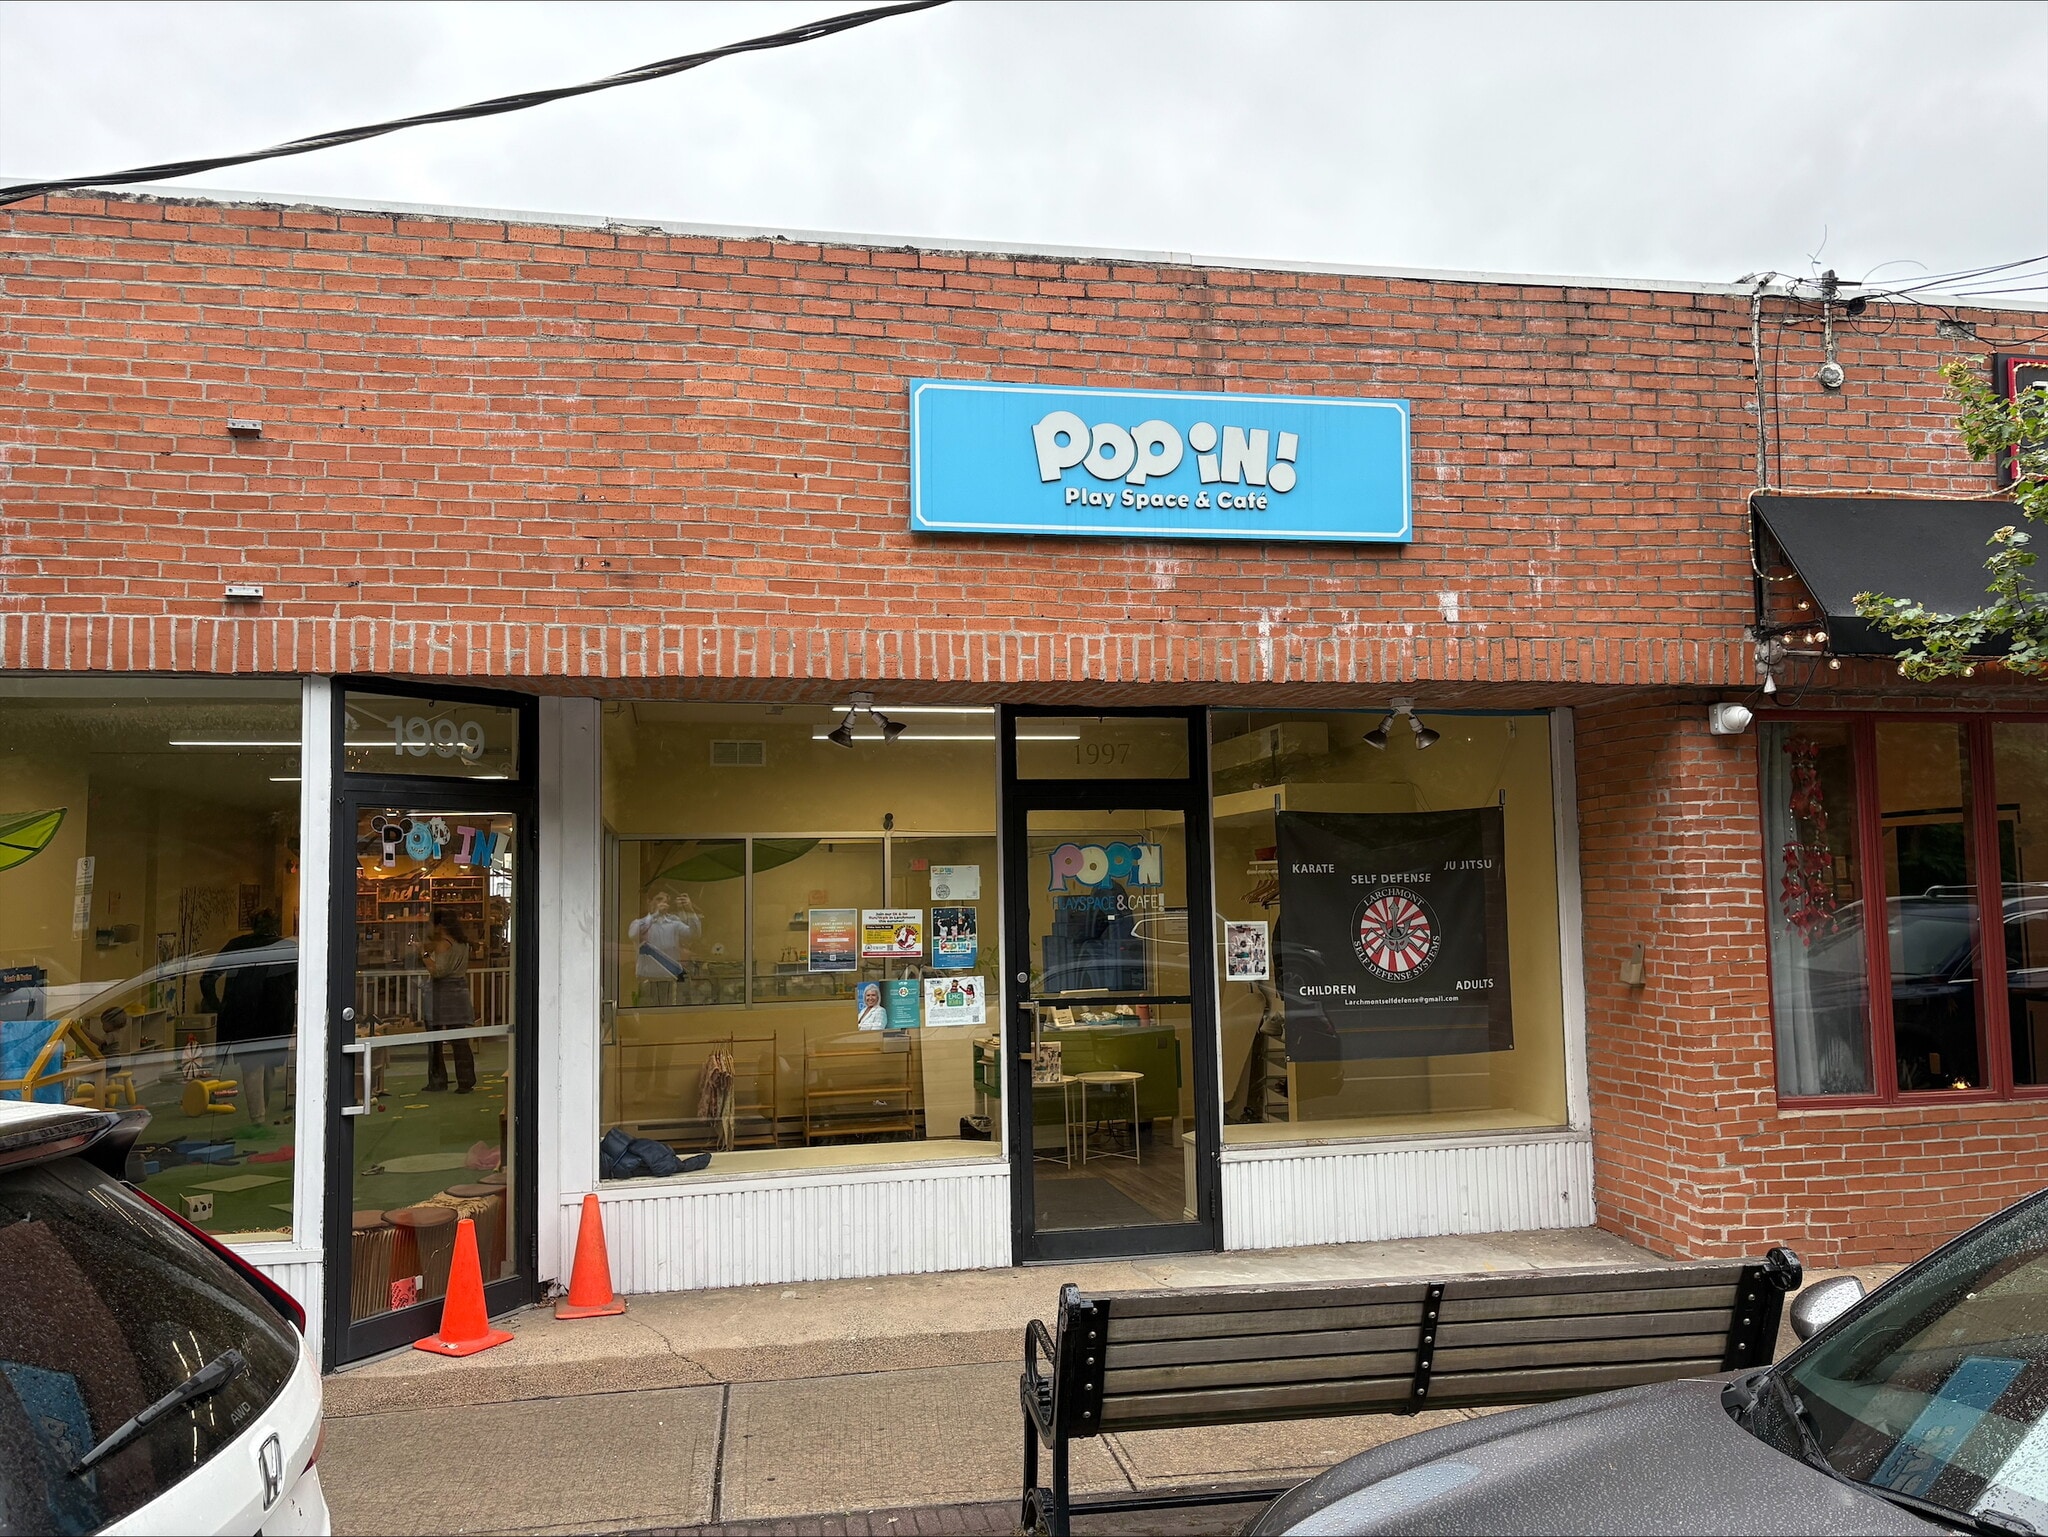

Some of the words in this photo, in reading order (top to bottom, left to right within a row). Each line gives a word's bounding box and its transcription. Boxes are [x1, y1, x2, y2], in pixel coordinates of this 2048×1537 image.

[1065, 487, 1114, 510] Play
[1121, 488, 1190, 512] Space
[1195, 491, 1211, 509] &
[1217, 491, 1268, 511] Café
[387, 715, 485, 760] 1999
[1073, 743, 1131, 765] 1997
[1292, 863, 1336, 874] KARATE
[1443, 860, 1457, 871] JU
[1460, 859, 1493, 870] JITSU
[1351, 874, 1377, 885] SELF
[1381, 873, 1432, 884] DEFENSE
[1116, 894, 1128, 911] &
[1364, 888, 1424, 906] LARCHMONT
[1354, 940, 1369, 965] SELF
[1368, 962, 1413, 981] DEFENSE
[1413, 935, 1440, 974] SYSTEMS
[1299, 985, 1356, 996] CHILDREN
[1455, 979, 1494, 990] ADULTS
[1345, 995, 1459, 1006] Larchmontselfdefense@gmail.com
[230, 1401, 251, 1425] AWD
